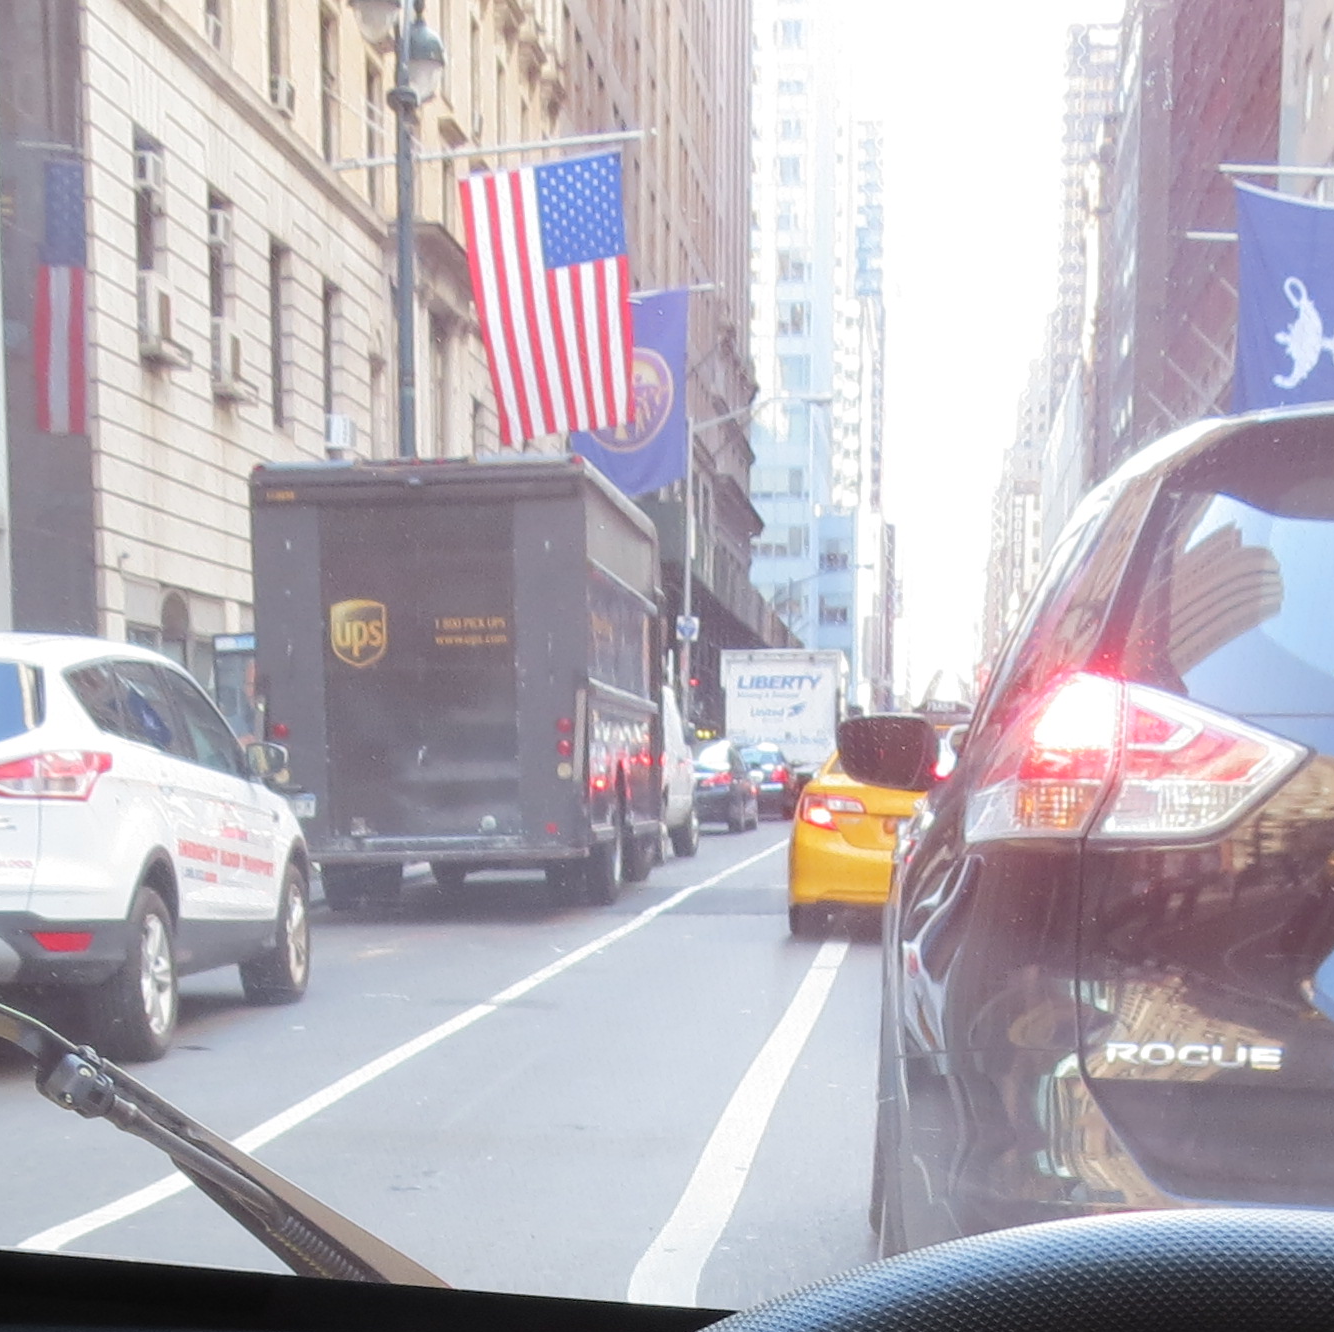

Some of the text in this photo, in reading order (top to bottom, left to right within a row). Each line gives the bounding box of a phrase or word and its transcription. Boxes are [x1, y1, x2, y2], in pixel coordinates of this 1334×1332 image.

[335, 619, 383, 658] ups
[737, 674, 823, 690] LIBERTY
[1106, 1041, 1283, 1071] ROGUE
